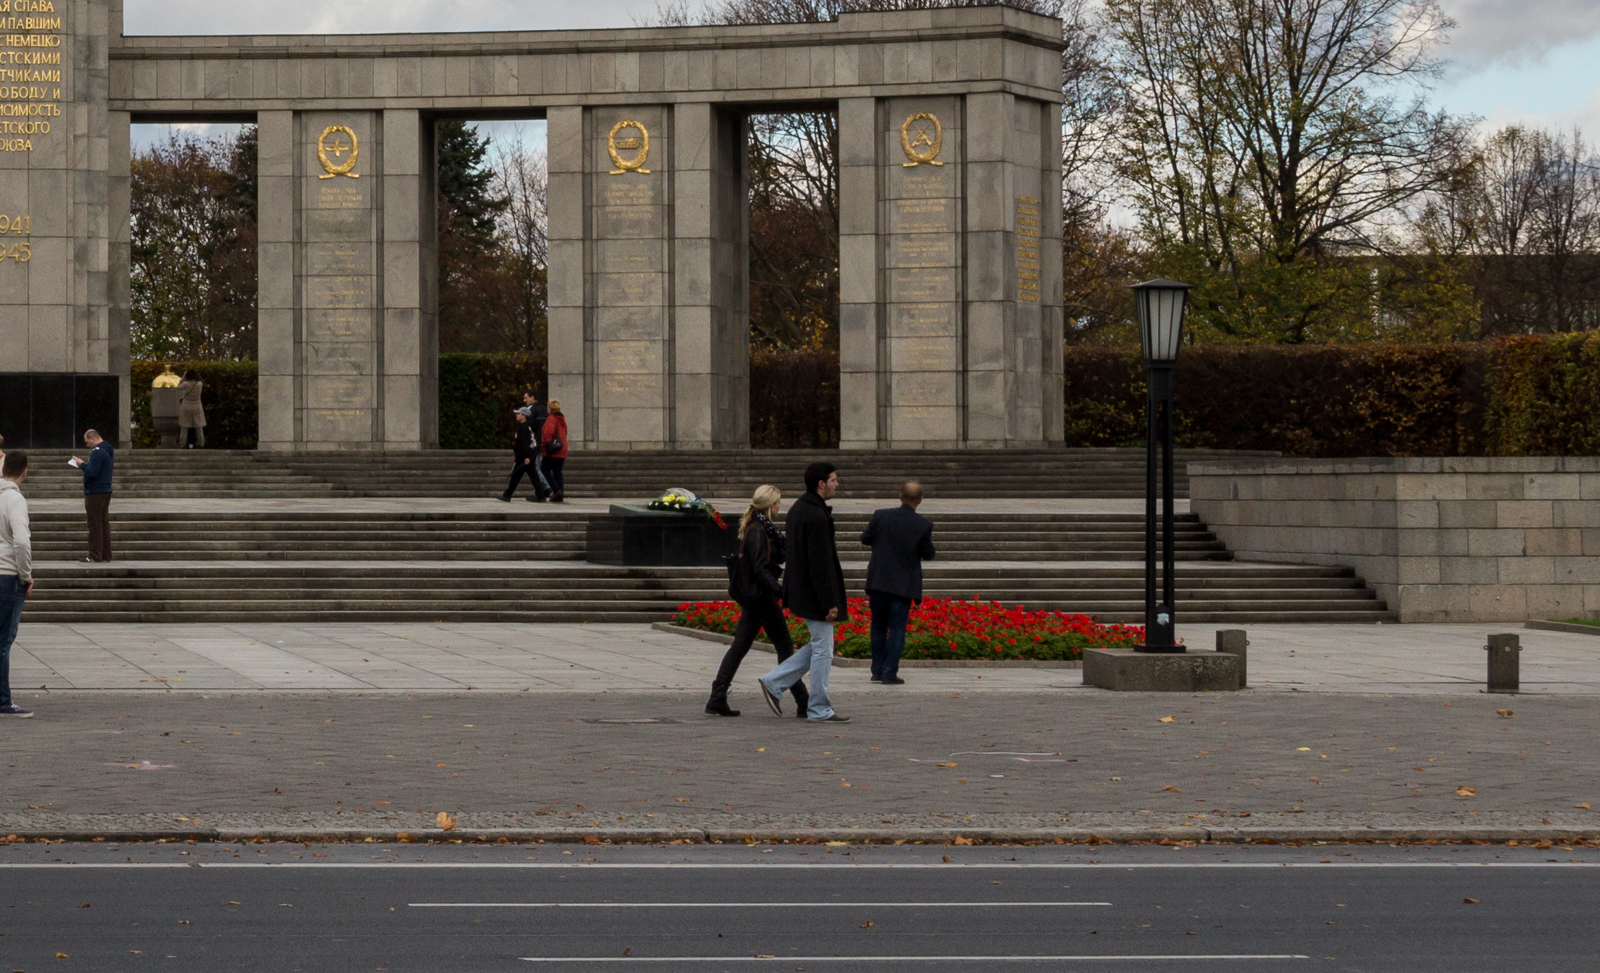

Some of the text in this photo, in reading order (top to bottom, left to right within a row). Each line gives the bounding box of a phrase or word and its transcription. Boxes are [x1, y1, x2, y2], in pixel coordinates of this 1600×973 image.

[14, 0, 54, 12] СЛАВА
[8, 17, 60, 29] ПАВШИМ
[6, 35, 60, 47] НЕМЕЦКО
